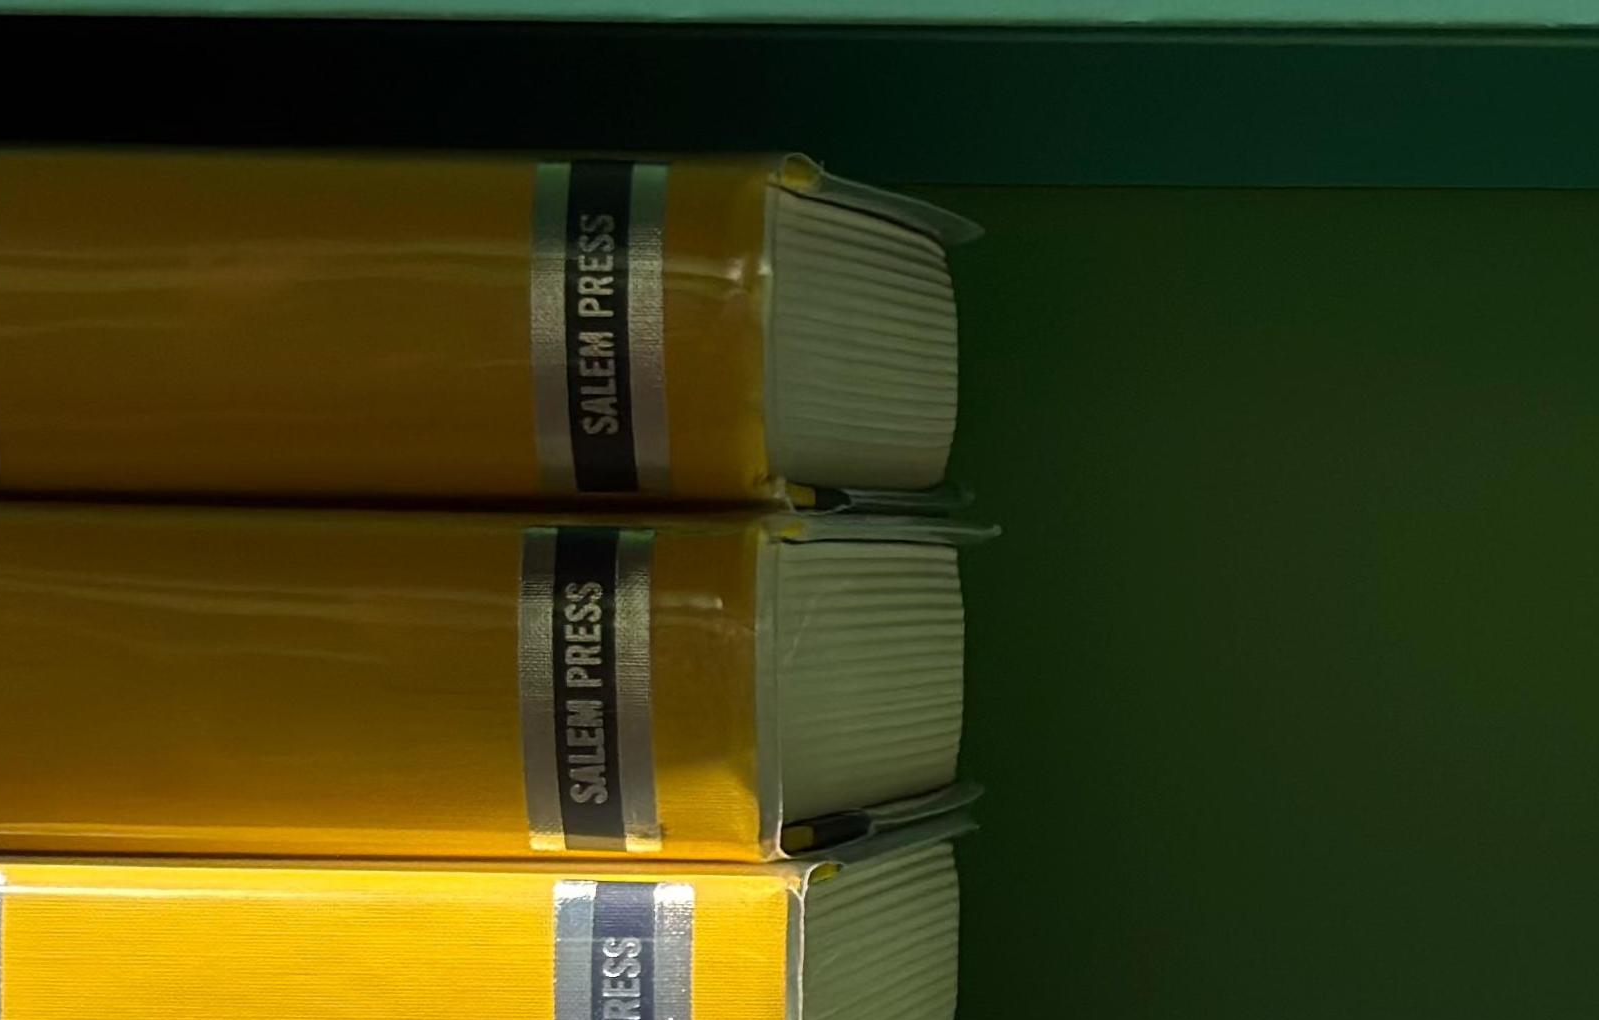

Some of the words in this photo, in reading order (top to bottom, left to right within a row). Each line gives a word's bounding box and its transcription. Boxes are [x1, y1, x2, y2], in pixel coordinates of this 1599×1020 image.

[578, 212, 615, 319] PRESS
[581, 328, 620, 435] SALEM
[566, 580, 603, 687] PRESS
[570, 697, 608, 804] SALEM
